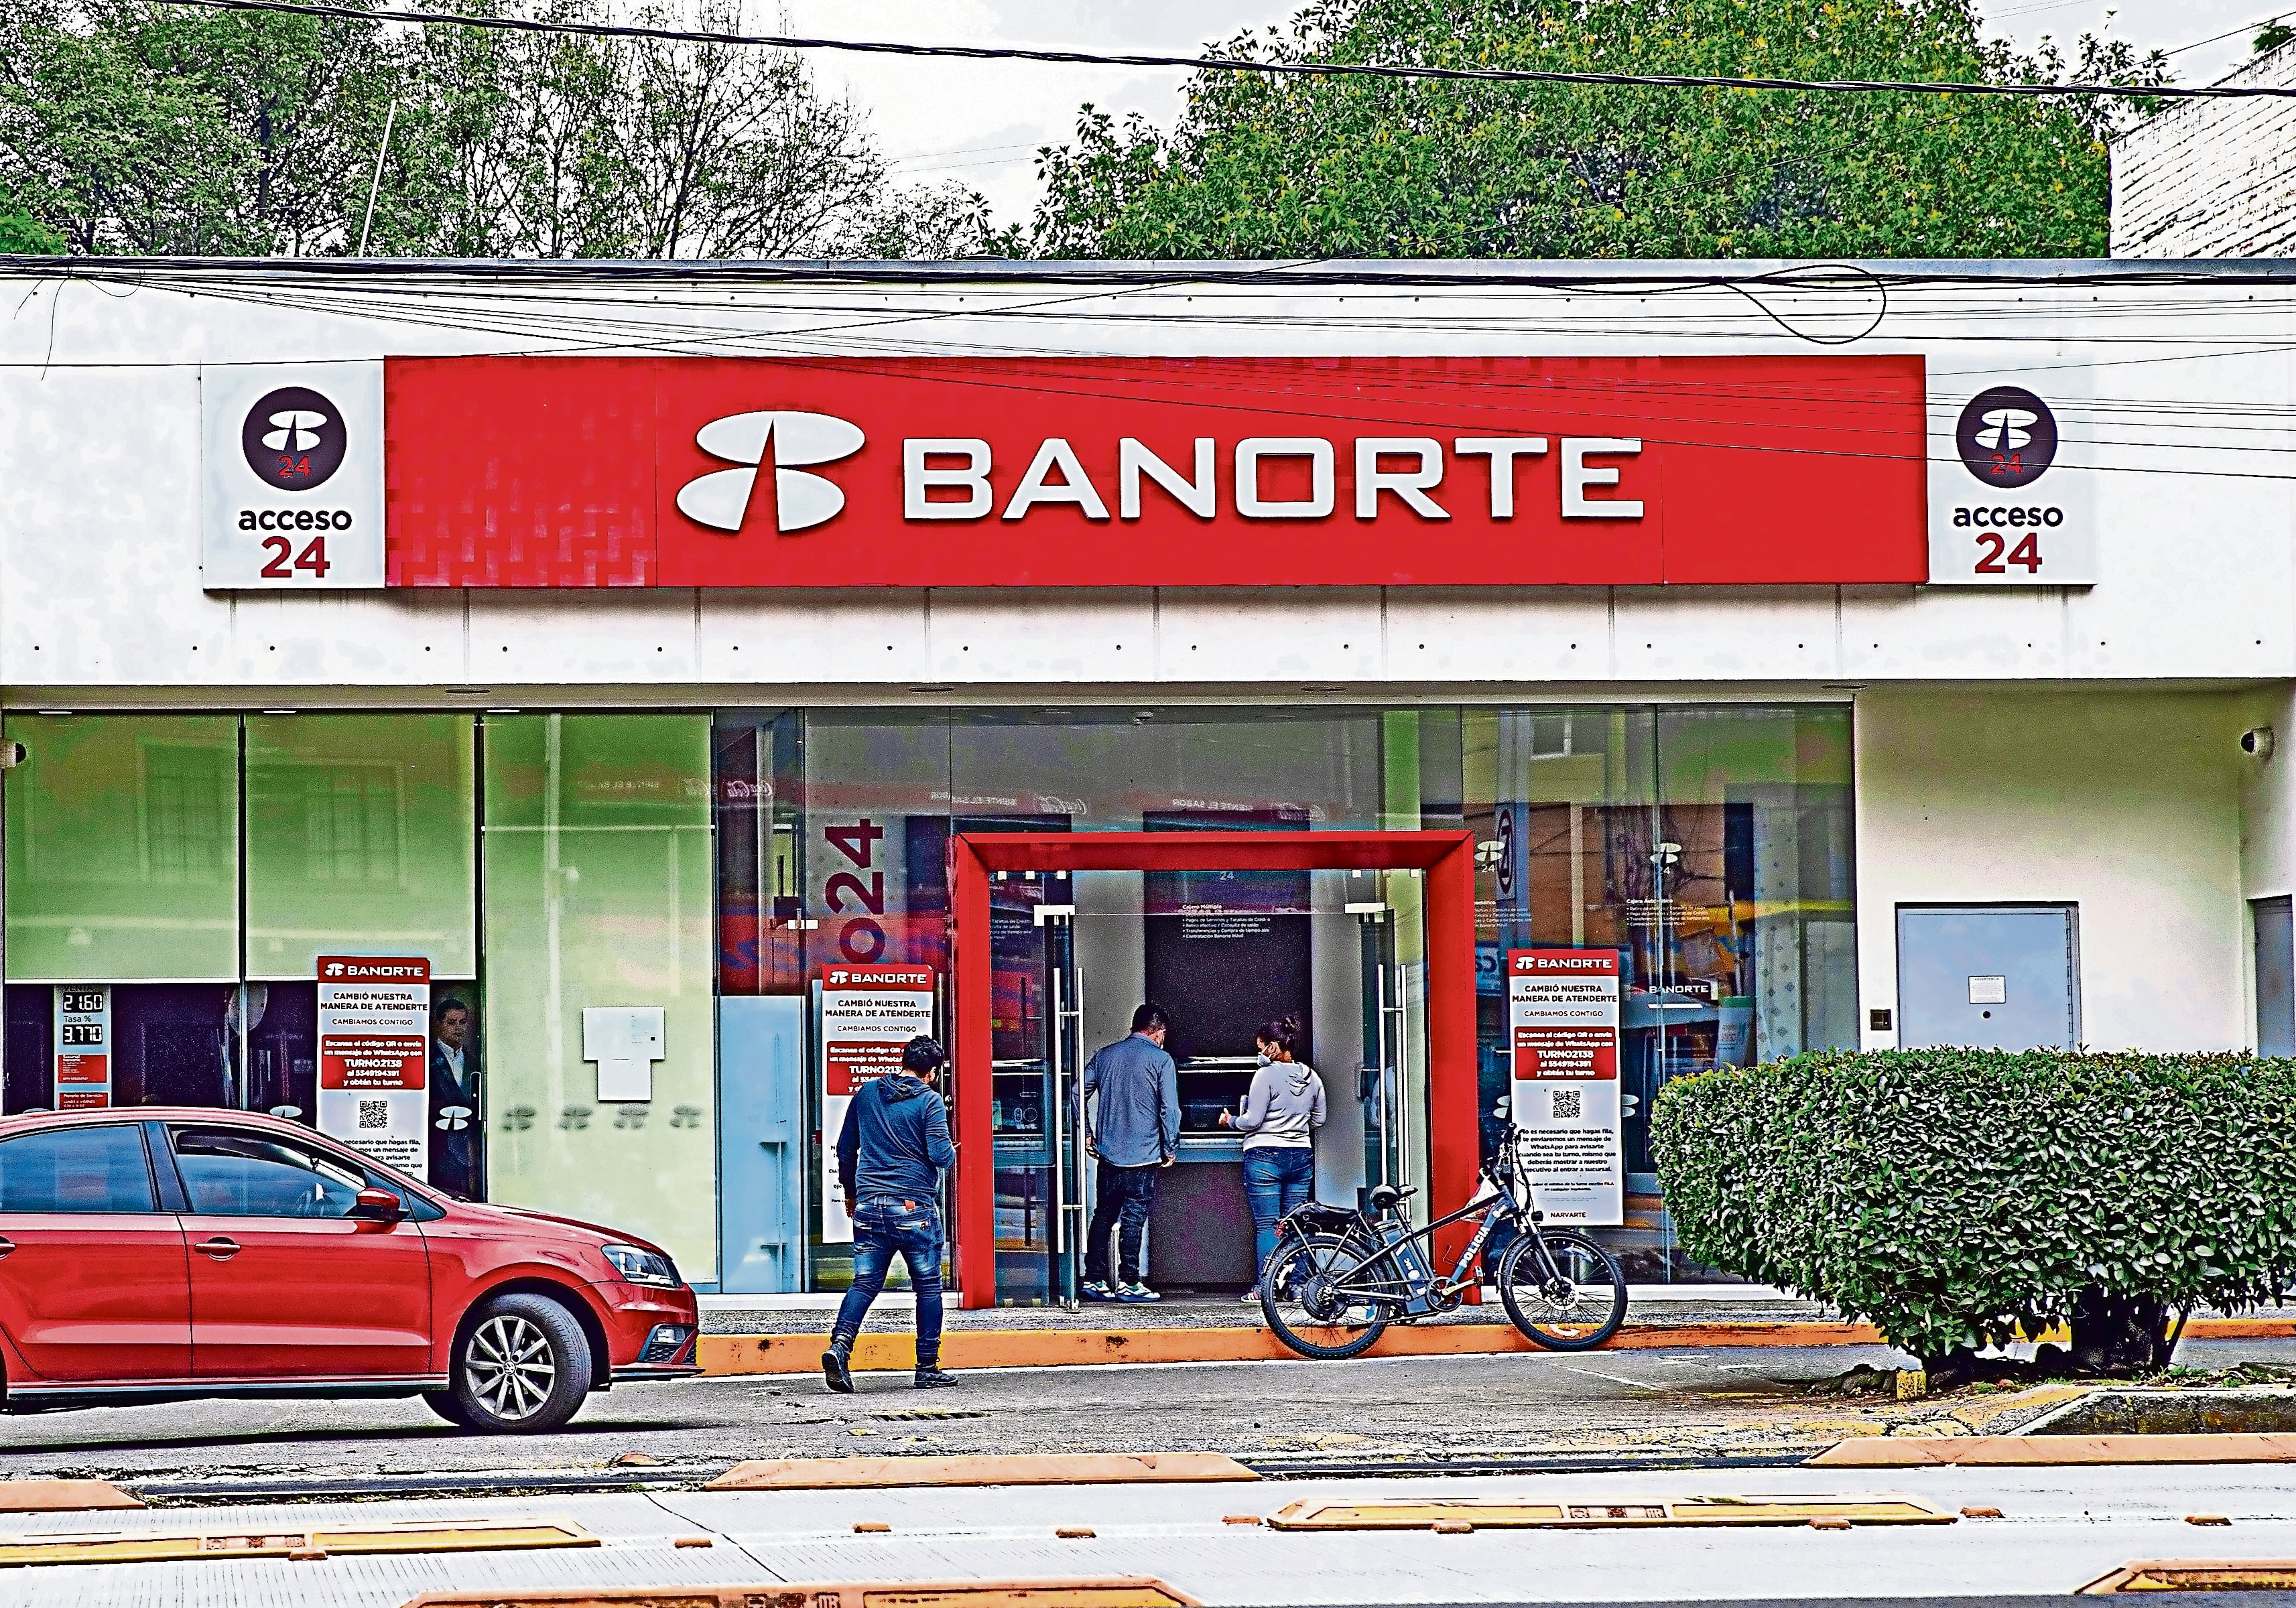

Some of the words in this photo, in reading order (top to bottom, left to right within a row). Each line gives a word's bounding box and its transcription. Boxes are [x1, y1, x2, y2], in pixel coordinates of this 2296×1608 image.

[277, 455, 312, 477] 24
[1990, 453, 2023, 474] 24
[902, 436, 1644, 521] BANORTE
[239, 510, 353, 531] acceso
[1953, 507, 2063, 527] acceso
[261, 535, 331, 578] 24
[1974, 532, 2043, 574] 24
[1482, 864, 1495, 872] 24
[1220, 871, 1234, 880] 24
[1537, 959, 1612, 968] BANORTE
[348, 966, 424, 976] BANORTE
[851, 974, 927, 984] BANORTE
[334, 992, 369, 1000] CAMBIÓ
[838, 998, 873, 1006] CAMBIÓ
[64, 1026, 102, 1042] 3.770
[334, 1049, 362, 1057] mensaje
[373, 1049, 409, 1057] WhatsApp
[866, 1047, 889, 1055] código
[1537, 1051, 1594, 1059] TURNO2138
[344, 1059, 403, 1068] TURNO2138
